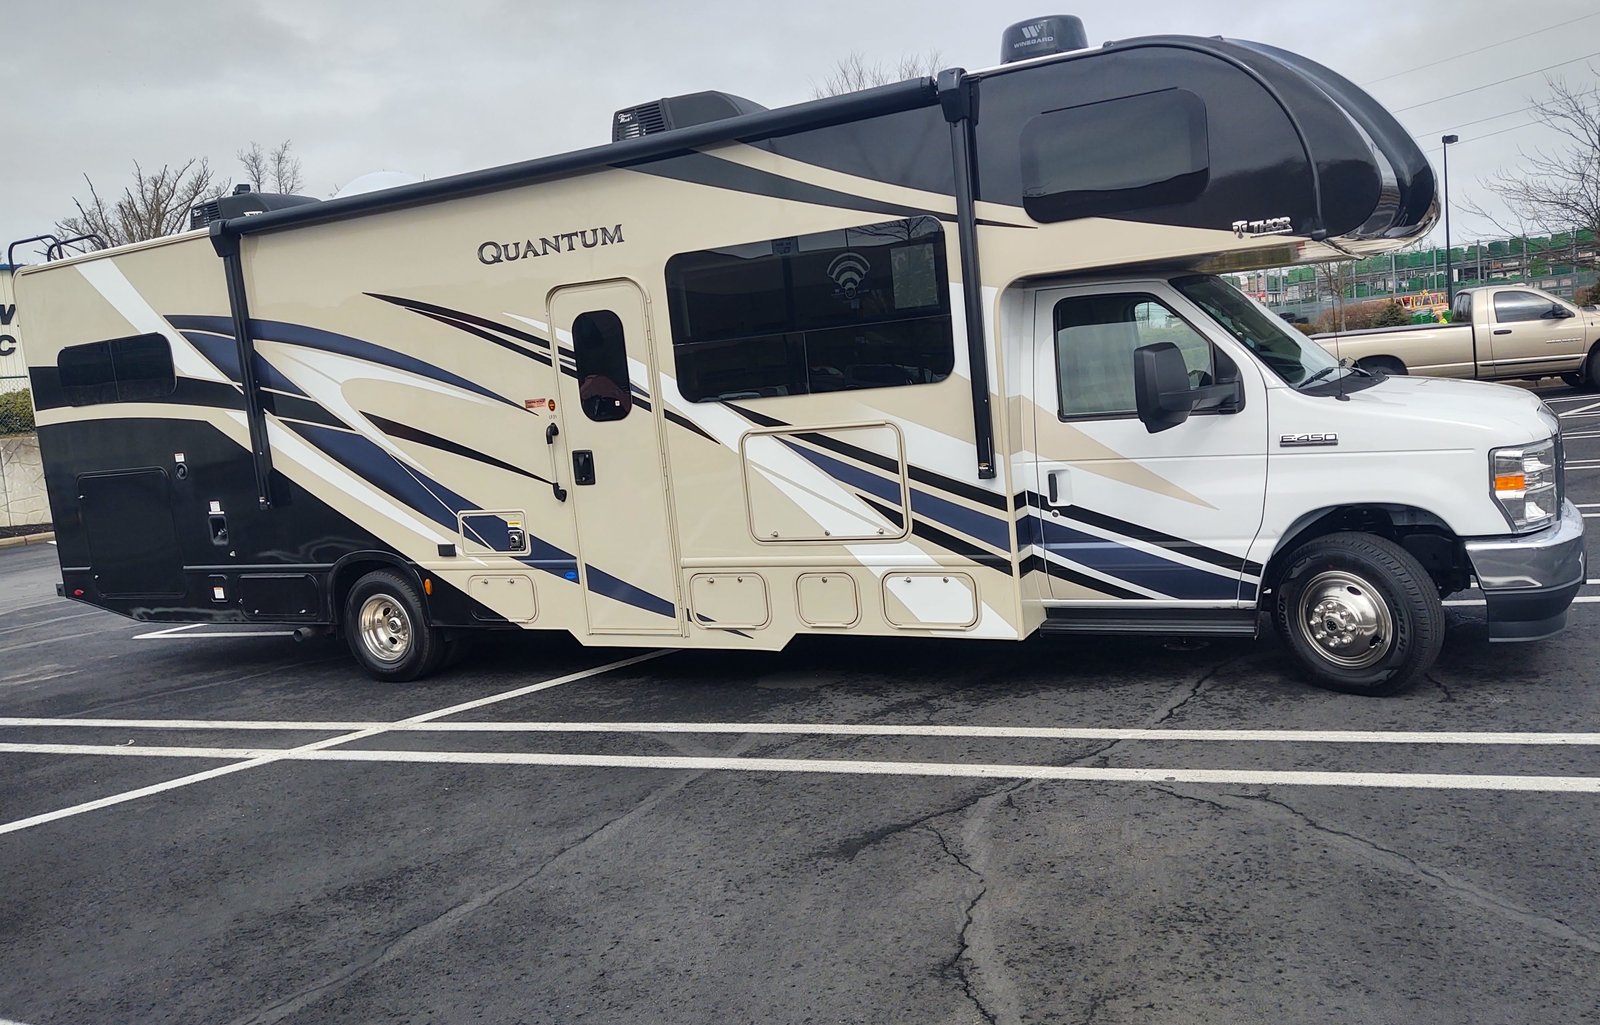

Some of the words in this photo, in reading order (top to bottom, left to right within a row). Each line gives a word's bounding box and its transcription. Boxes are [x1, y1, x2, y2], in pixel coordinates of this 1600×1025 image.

[1013, 36, 1054, 49] WINEGARD
[1248, 216, 1293, 234] THOR
[1280, 432, 1338, 444] E-450
